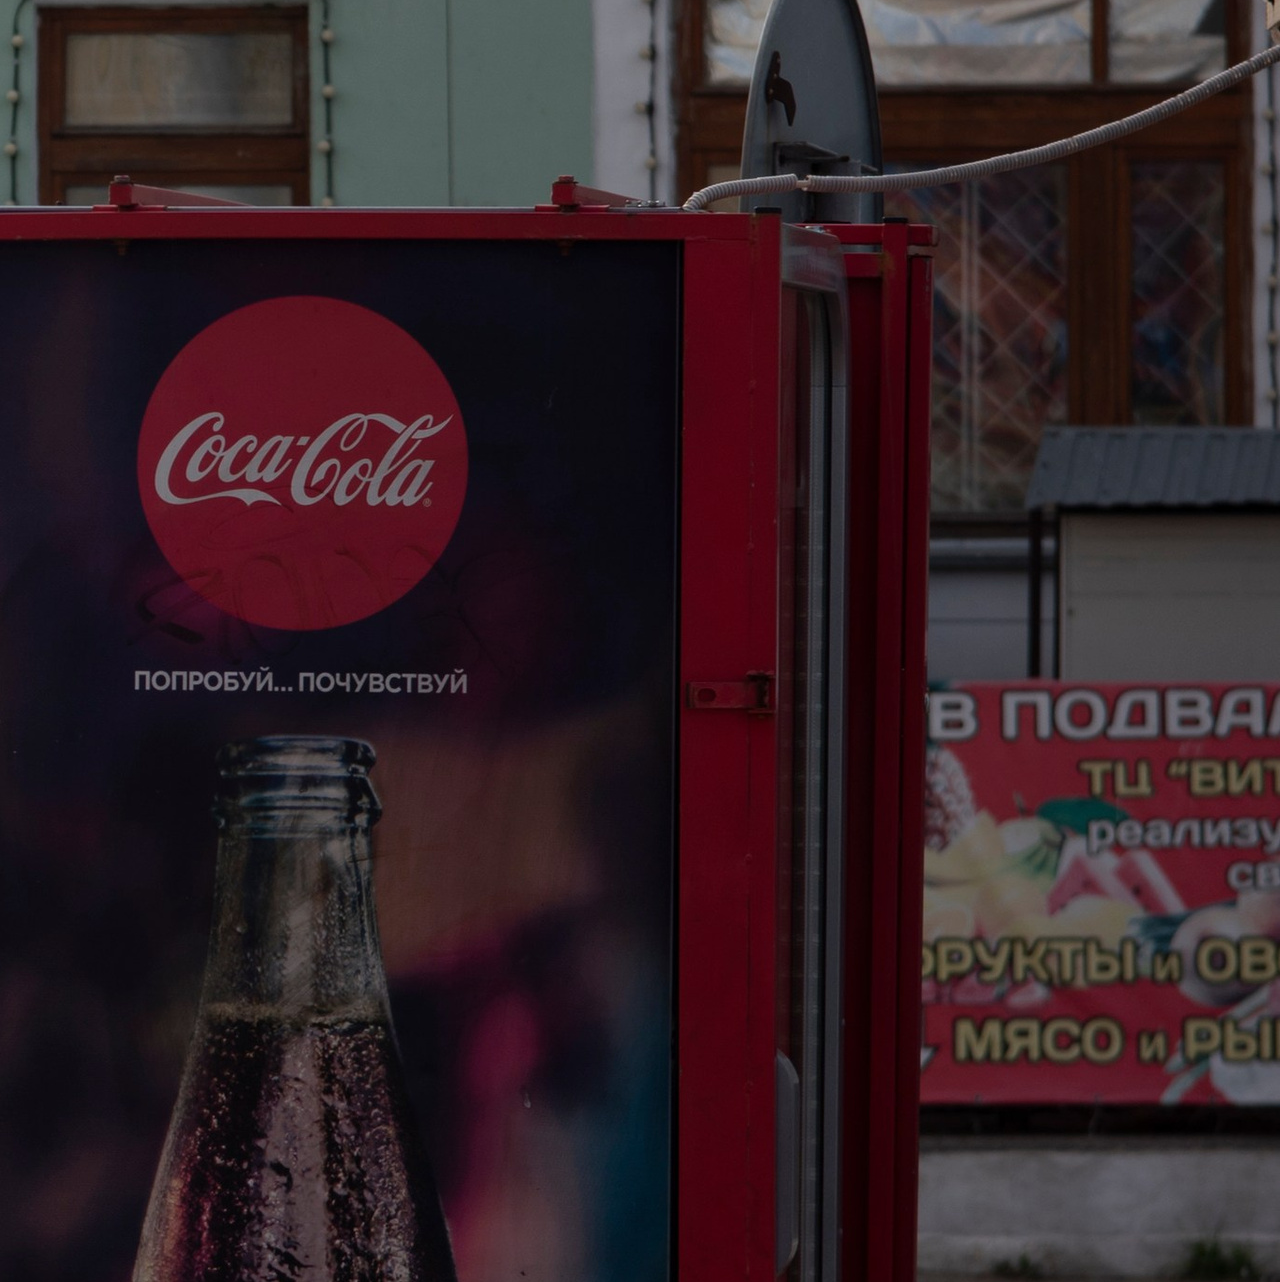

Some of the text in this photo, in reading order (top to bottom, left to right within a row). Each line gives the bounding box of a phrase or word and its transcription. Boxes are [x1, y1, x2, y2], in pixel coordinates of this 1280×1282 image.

[154, 412, 453, 506] Coca-Cola
[134, 664, 467, 694] ПОПРОБУЙ... ПОЧУВСТВУЙ
[929, 690, 978, 741] В
[1080, 760, 1153, 797] ТЦ
[1155, 952, 1182, 982] и
[1196, 937, 1280, 983] ОВ
[954, 1017, 1280, 1063] МЯСО и РЫ
